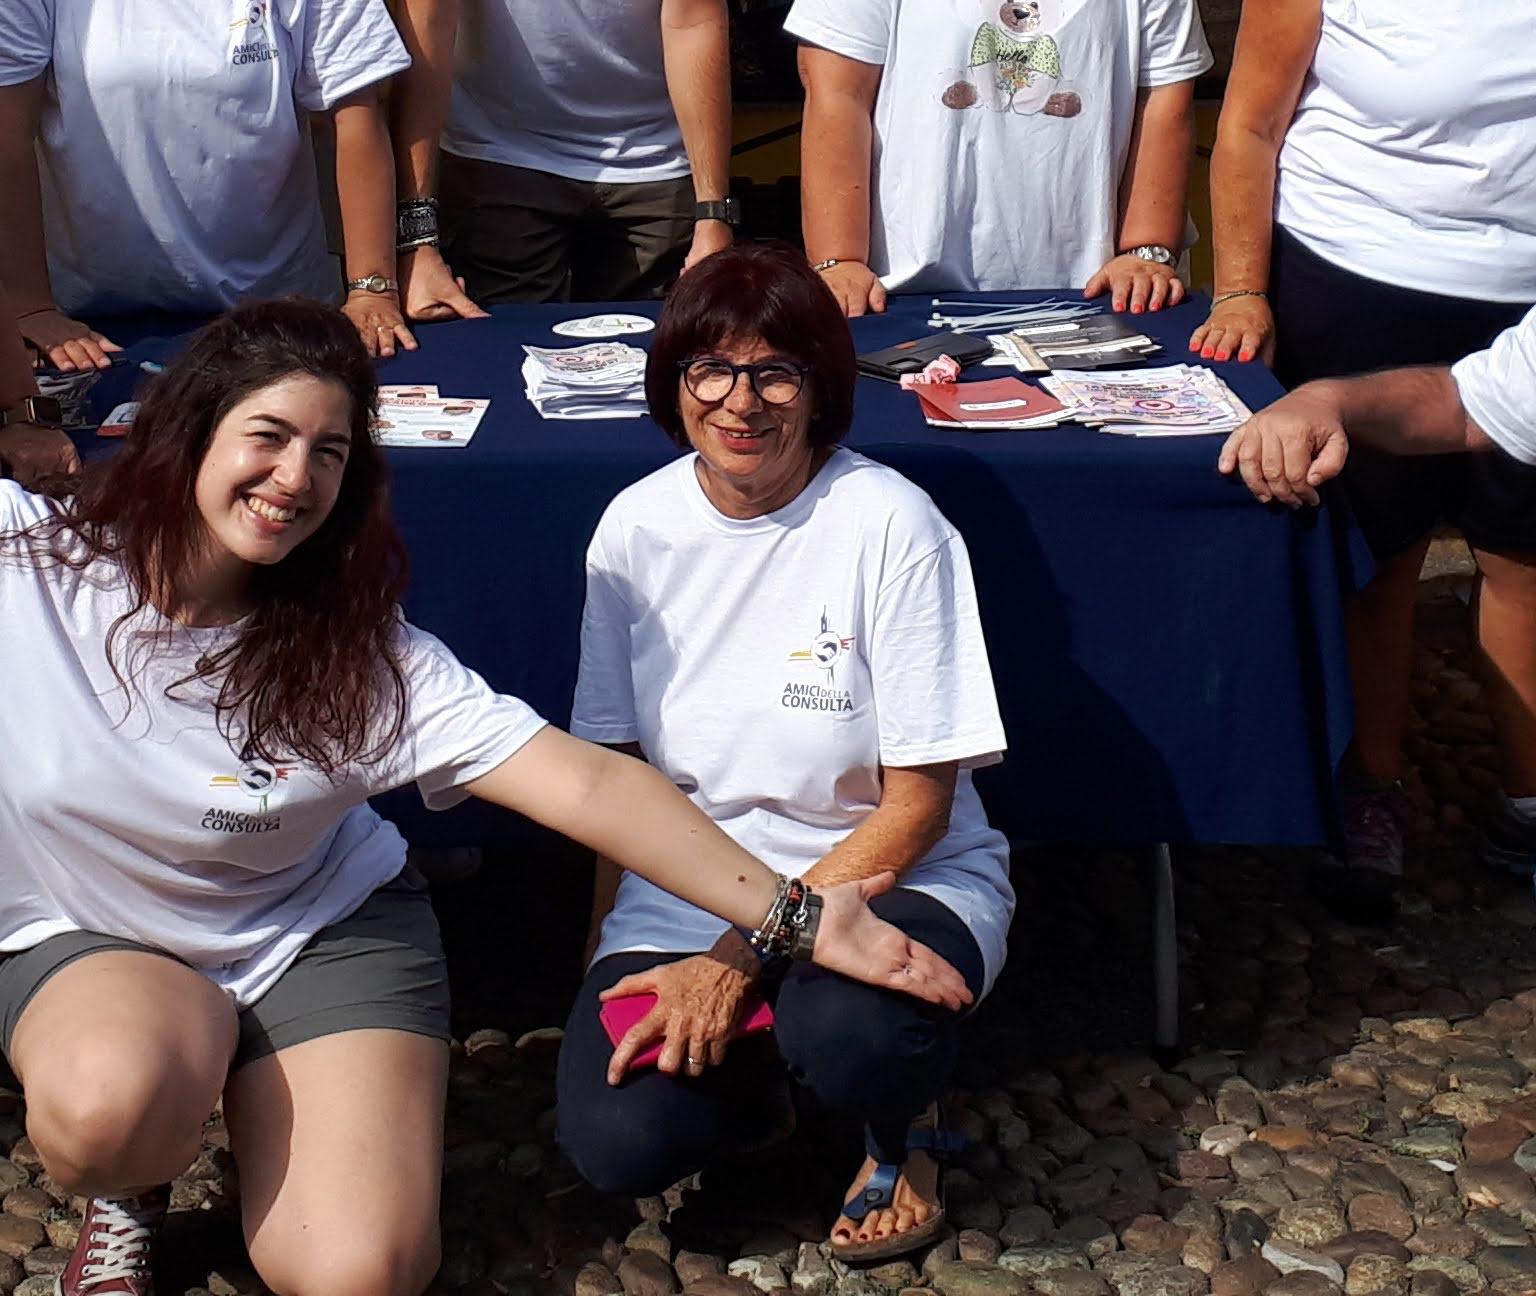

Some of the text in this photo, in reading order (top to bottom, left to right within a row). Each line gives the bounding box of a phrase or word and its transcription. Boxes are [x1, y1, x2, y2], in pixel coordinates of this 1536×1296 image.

[783, 682, 851, 699] AMICI DELLA
[781, 694, 855, 712] CONSULTA
[204, 807, 249, 823] AMICI
[201, 817, 281, 833] CONSULTA
